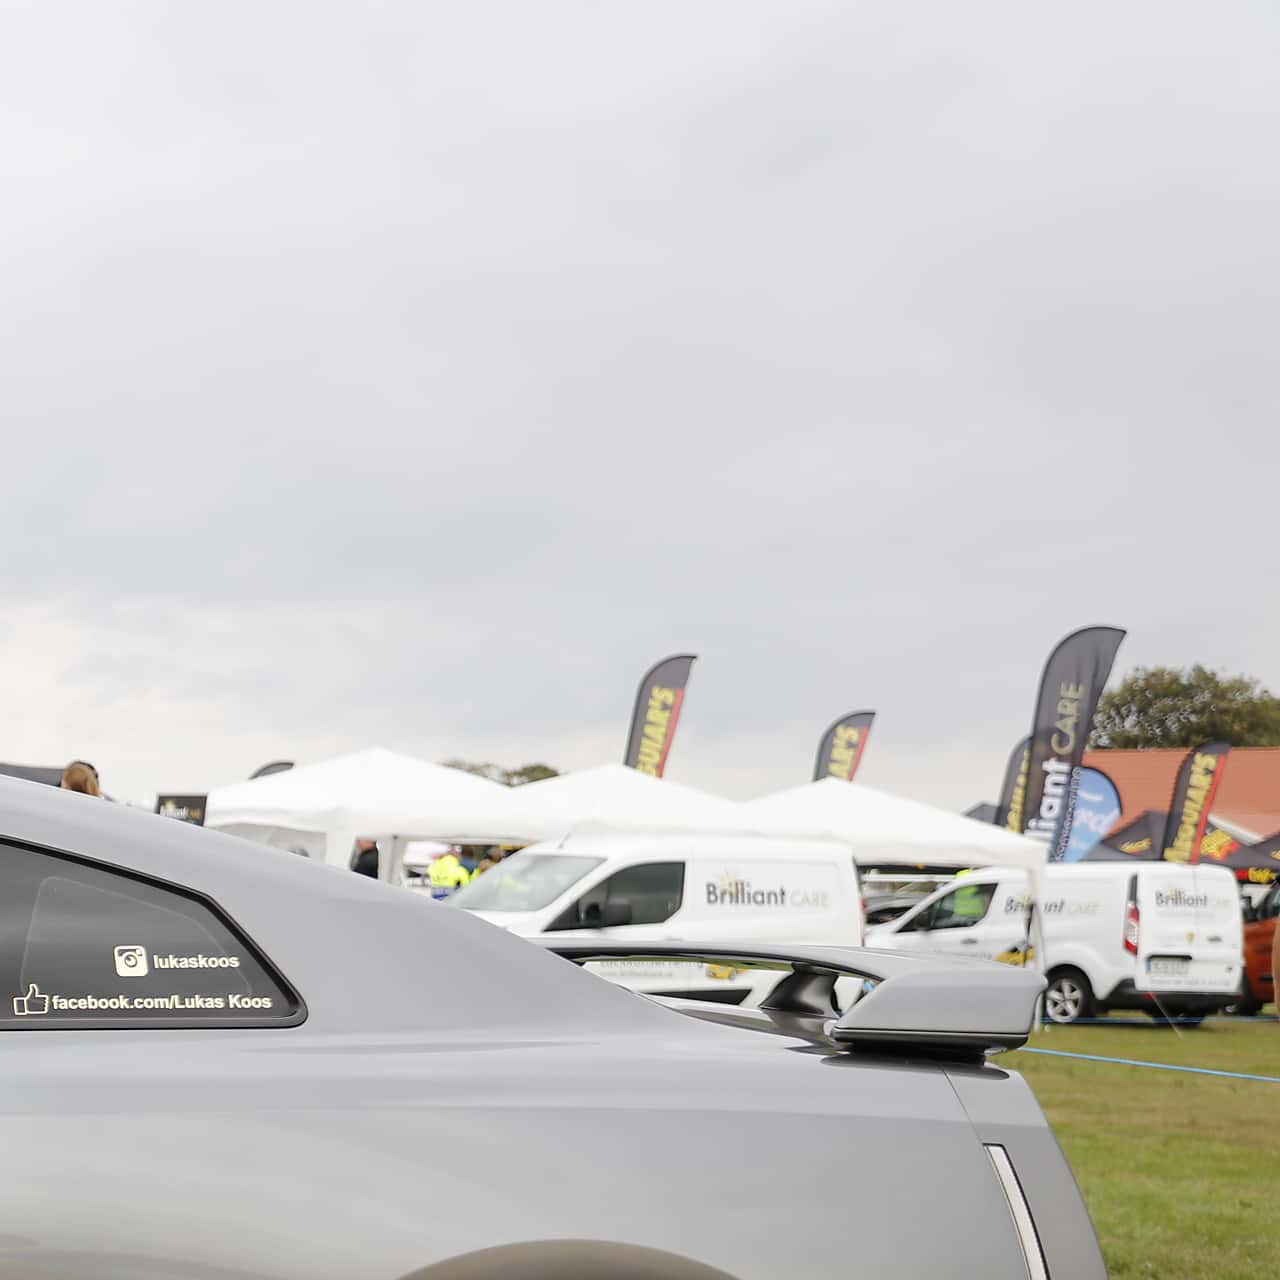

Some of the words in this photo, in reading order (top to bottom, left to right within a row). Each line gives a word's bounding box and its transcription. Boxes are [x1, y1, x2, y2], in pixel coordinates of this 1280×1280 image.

[1052, 680, 1084, 755] CARE
[705, 880, 786, 905] Brilliant
[153, 953, 240, 969] lukaskoos
[51, 993, 224, 1010] facebook.com/Lukas
[228, 994, 272, 1009] Koos
